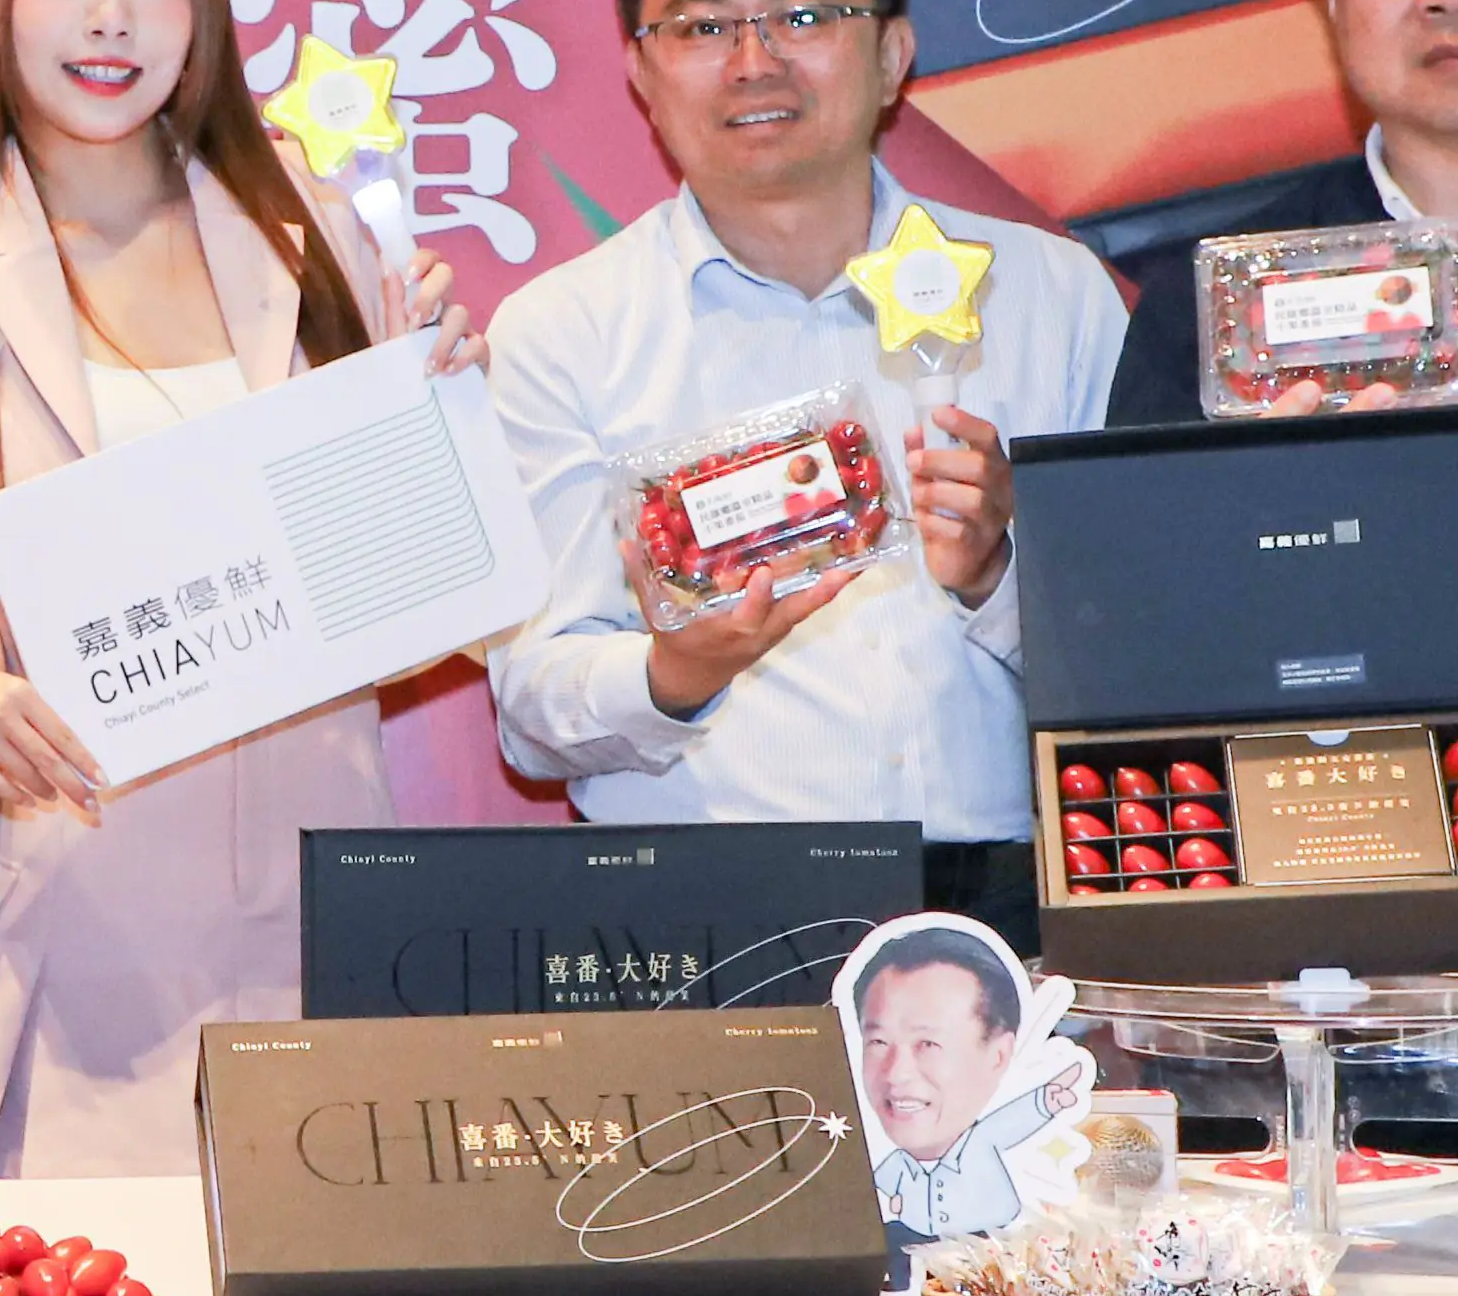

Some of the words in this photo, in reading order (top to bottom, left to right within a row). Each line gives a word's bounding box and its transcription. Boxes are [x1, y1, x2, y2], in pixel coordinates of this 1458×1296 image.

[71, 553, 272, 661] 嘉義優鮮
[89, 598, 291, 704] CHIAYUM
[104, 711, 136, 730] Chiayi
[139, 695, 177, 717] County
[176, 679, 210, 700] Select
[545, 953, 700, 985] 喜番·大好き
[458, 1119, 626, 1152] 喜番·大好き
